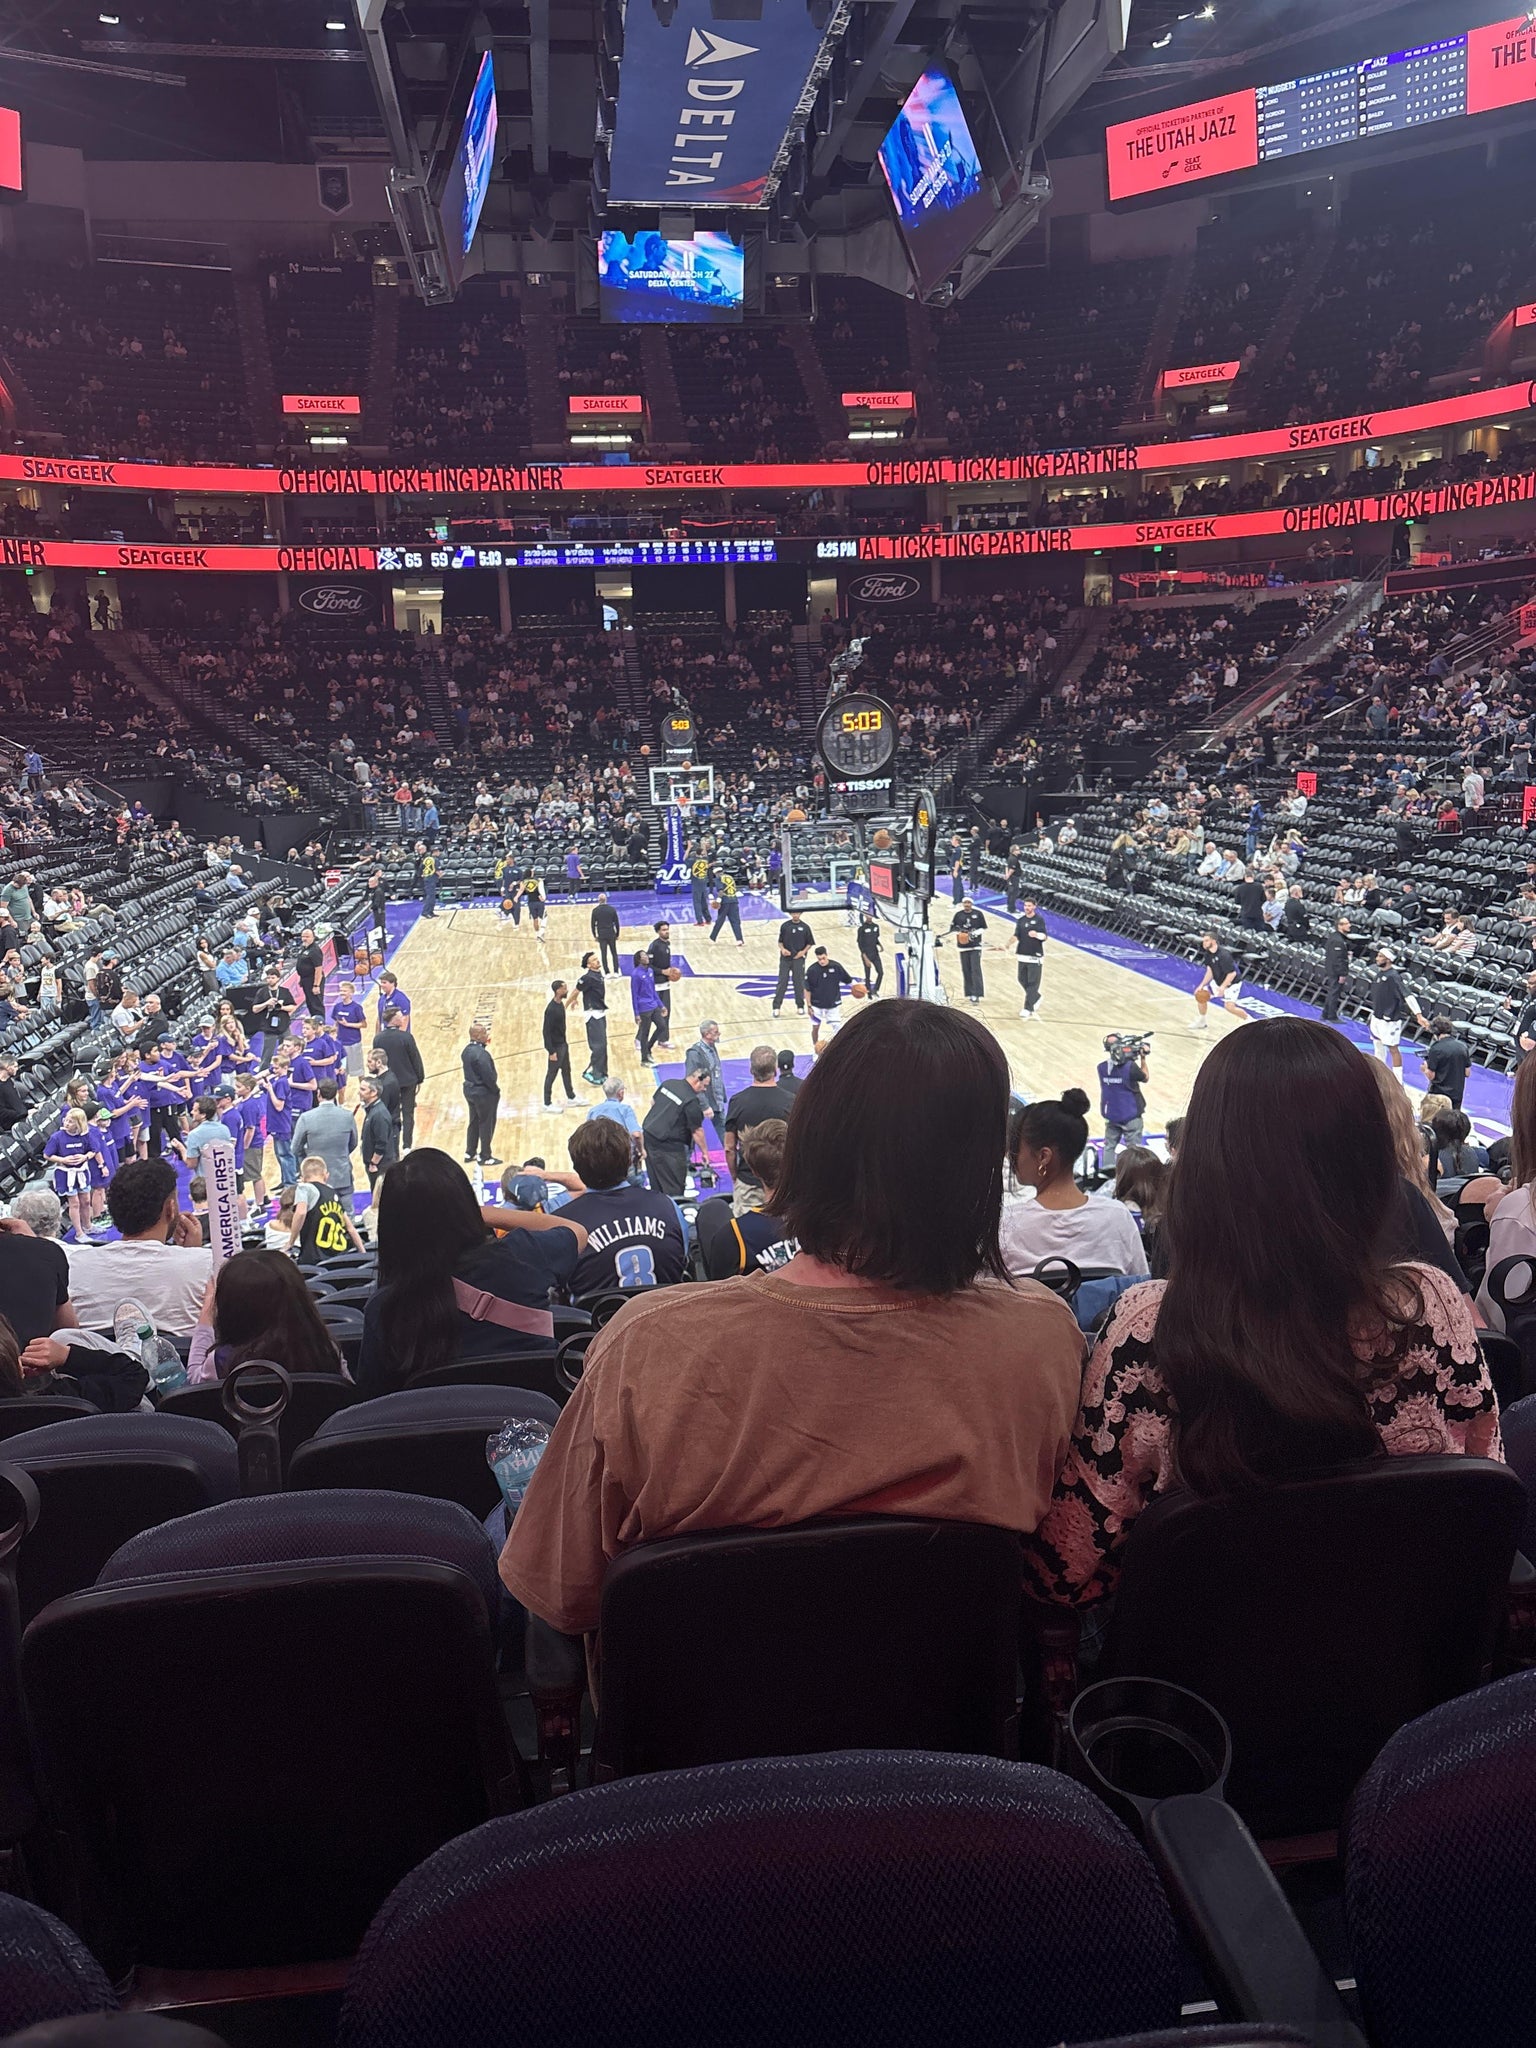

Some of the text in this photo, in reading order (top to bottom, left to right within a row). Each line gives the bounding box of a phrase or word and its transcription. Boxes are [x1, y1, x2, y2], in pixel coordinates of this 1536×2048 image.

[1371, 57, 1388, 68] JAZZ
[1491, 39, 1527, 69] THE
[664, 78, 746, 187] DELTA
[1136, 106, 1224, 136] OFFICIAL TICKETING PARTNER OF
[1126, 114, 1237, 161] THE UTAH JAZZ
[1184, 155, 1201, 166] SEAT
[1184, 163, 1202, 173] GEEK
[647, 279, 696, 288] DELTA CENTER
[670, 270, 703, 279] MARCH
[704, 270, 715, 279] 27
[1178, 366, 1225, 383] SEATGEEK
[297, 398, 345, 411] SEATGEEK
[583, 398, 629, 410] SEATGEEK
[856, 395, 899, 406] SEATGEEK
[1288, 416, 1373, 448] SEATGEEK
[22, 459, 117, 484] SEATGEEK
[645, 467, 726, 487] SEATGEEK
[866, 446, 1139, 486] OFFICIAL TICKETING PARTNER
[278, 465, 563, 494] OFFICIAL TICKETING PARTNER
[1283, 498, 1368, 533] OFFICIAL
[1374, 481, 1478, 522] TICKETING
[1136, 519, 1217, 543] SEATGEEK
[840, 541, 857, 557] PM
[862, 527, 1072, 560] AL TICKETING PARTNER
[117, 547, 209, 569] SEATGEEK
[277, 547, 366, 571] OFFICIAL
[404, 552, 423, 568] 65
[430, 552, 449, 568] 59
[479, 550, 502, 567] 5:03
[860, 576, 908, 598] Ford
[312, 587, 363, 611] Ford
[671, 720, 690, 730] 5:03
[842, 710, 882, 733] 5:03
[846, 778, 892, 792] TISSOT
[212, 1148, 235, 1258] AMERICA FIRST
[227, 1157, 240, 1248] CREDIT UNION
[587, 1215, 666, 1253] WILLIAMS
[614, 1244, 657, 1288] 8
